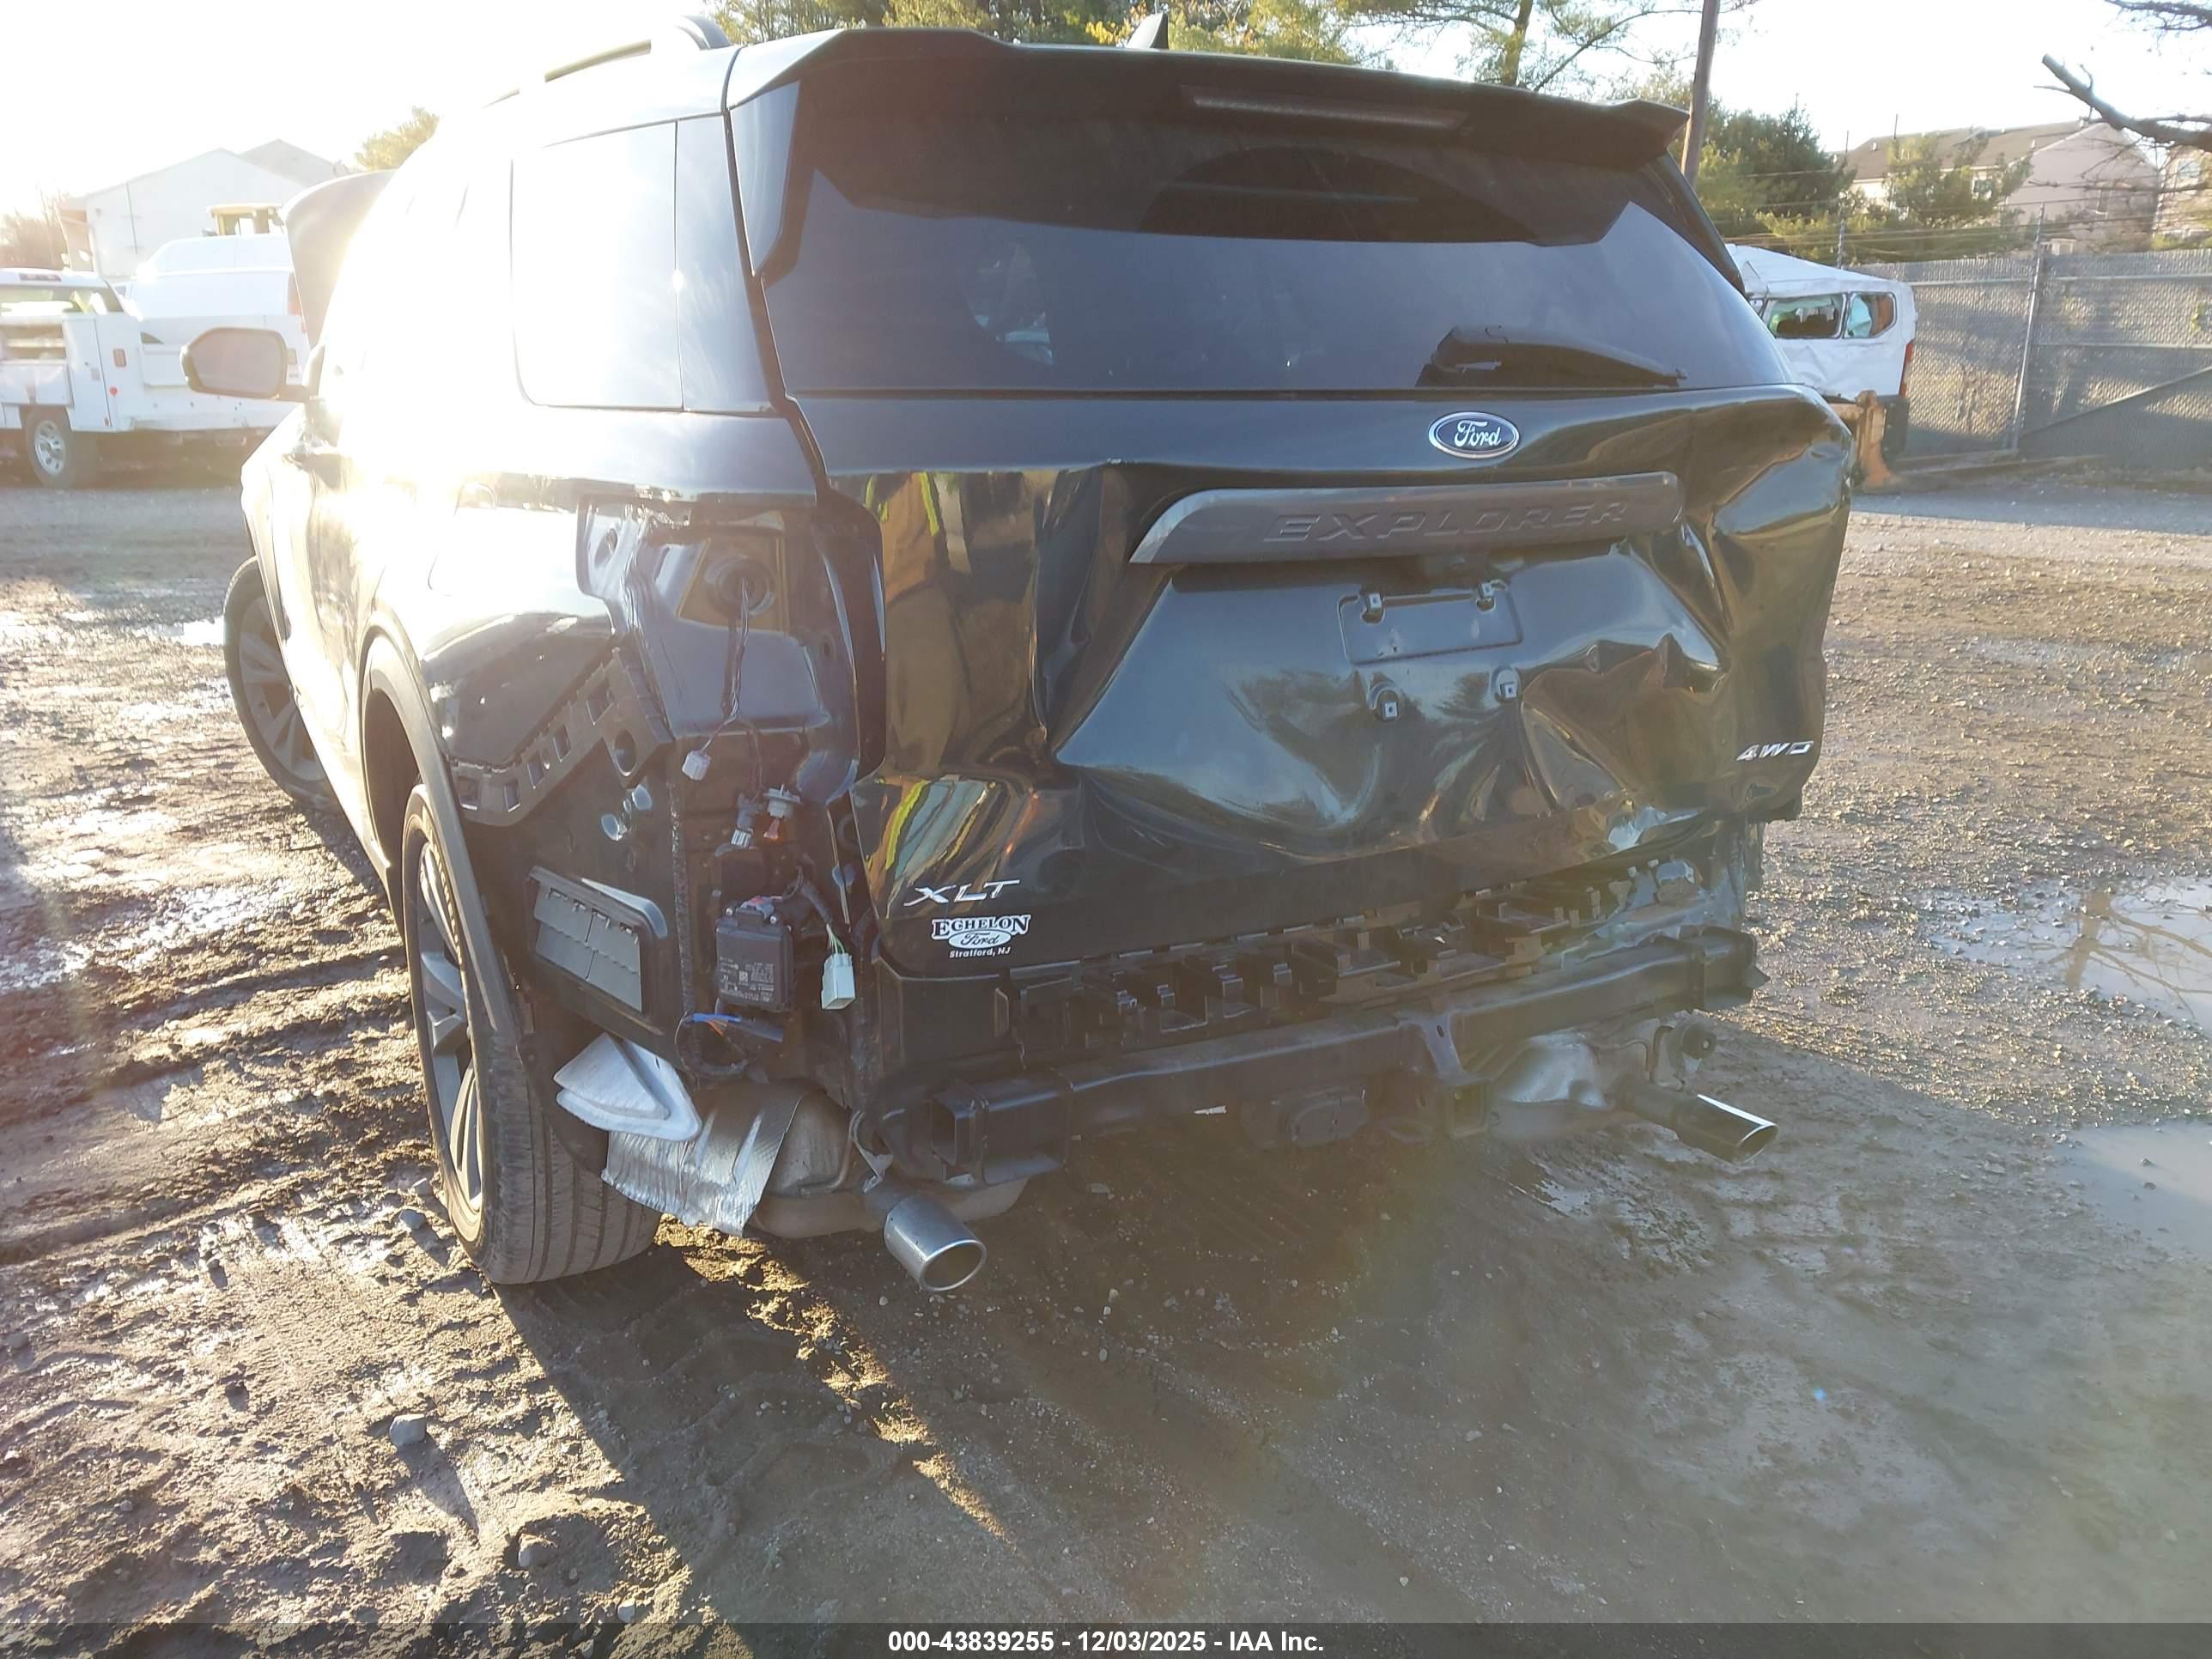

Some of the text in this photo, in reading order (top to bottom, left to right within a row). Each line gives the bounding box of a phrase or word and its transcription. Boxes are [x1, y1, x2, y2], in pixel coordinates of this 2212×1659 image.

[1454, 419, 1502, 447] Ford
[1262, 501, 1629, 543] EXPLORER
[1736, 740, 1814, 761] 4WD
[903, 879, 1020, 906] XLT
[933, 915, 1030, 939] ECHELON
[960, 933, 1000, 946] Ford
[949, 946, 1012, 959] Stratford, NJ
